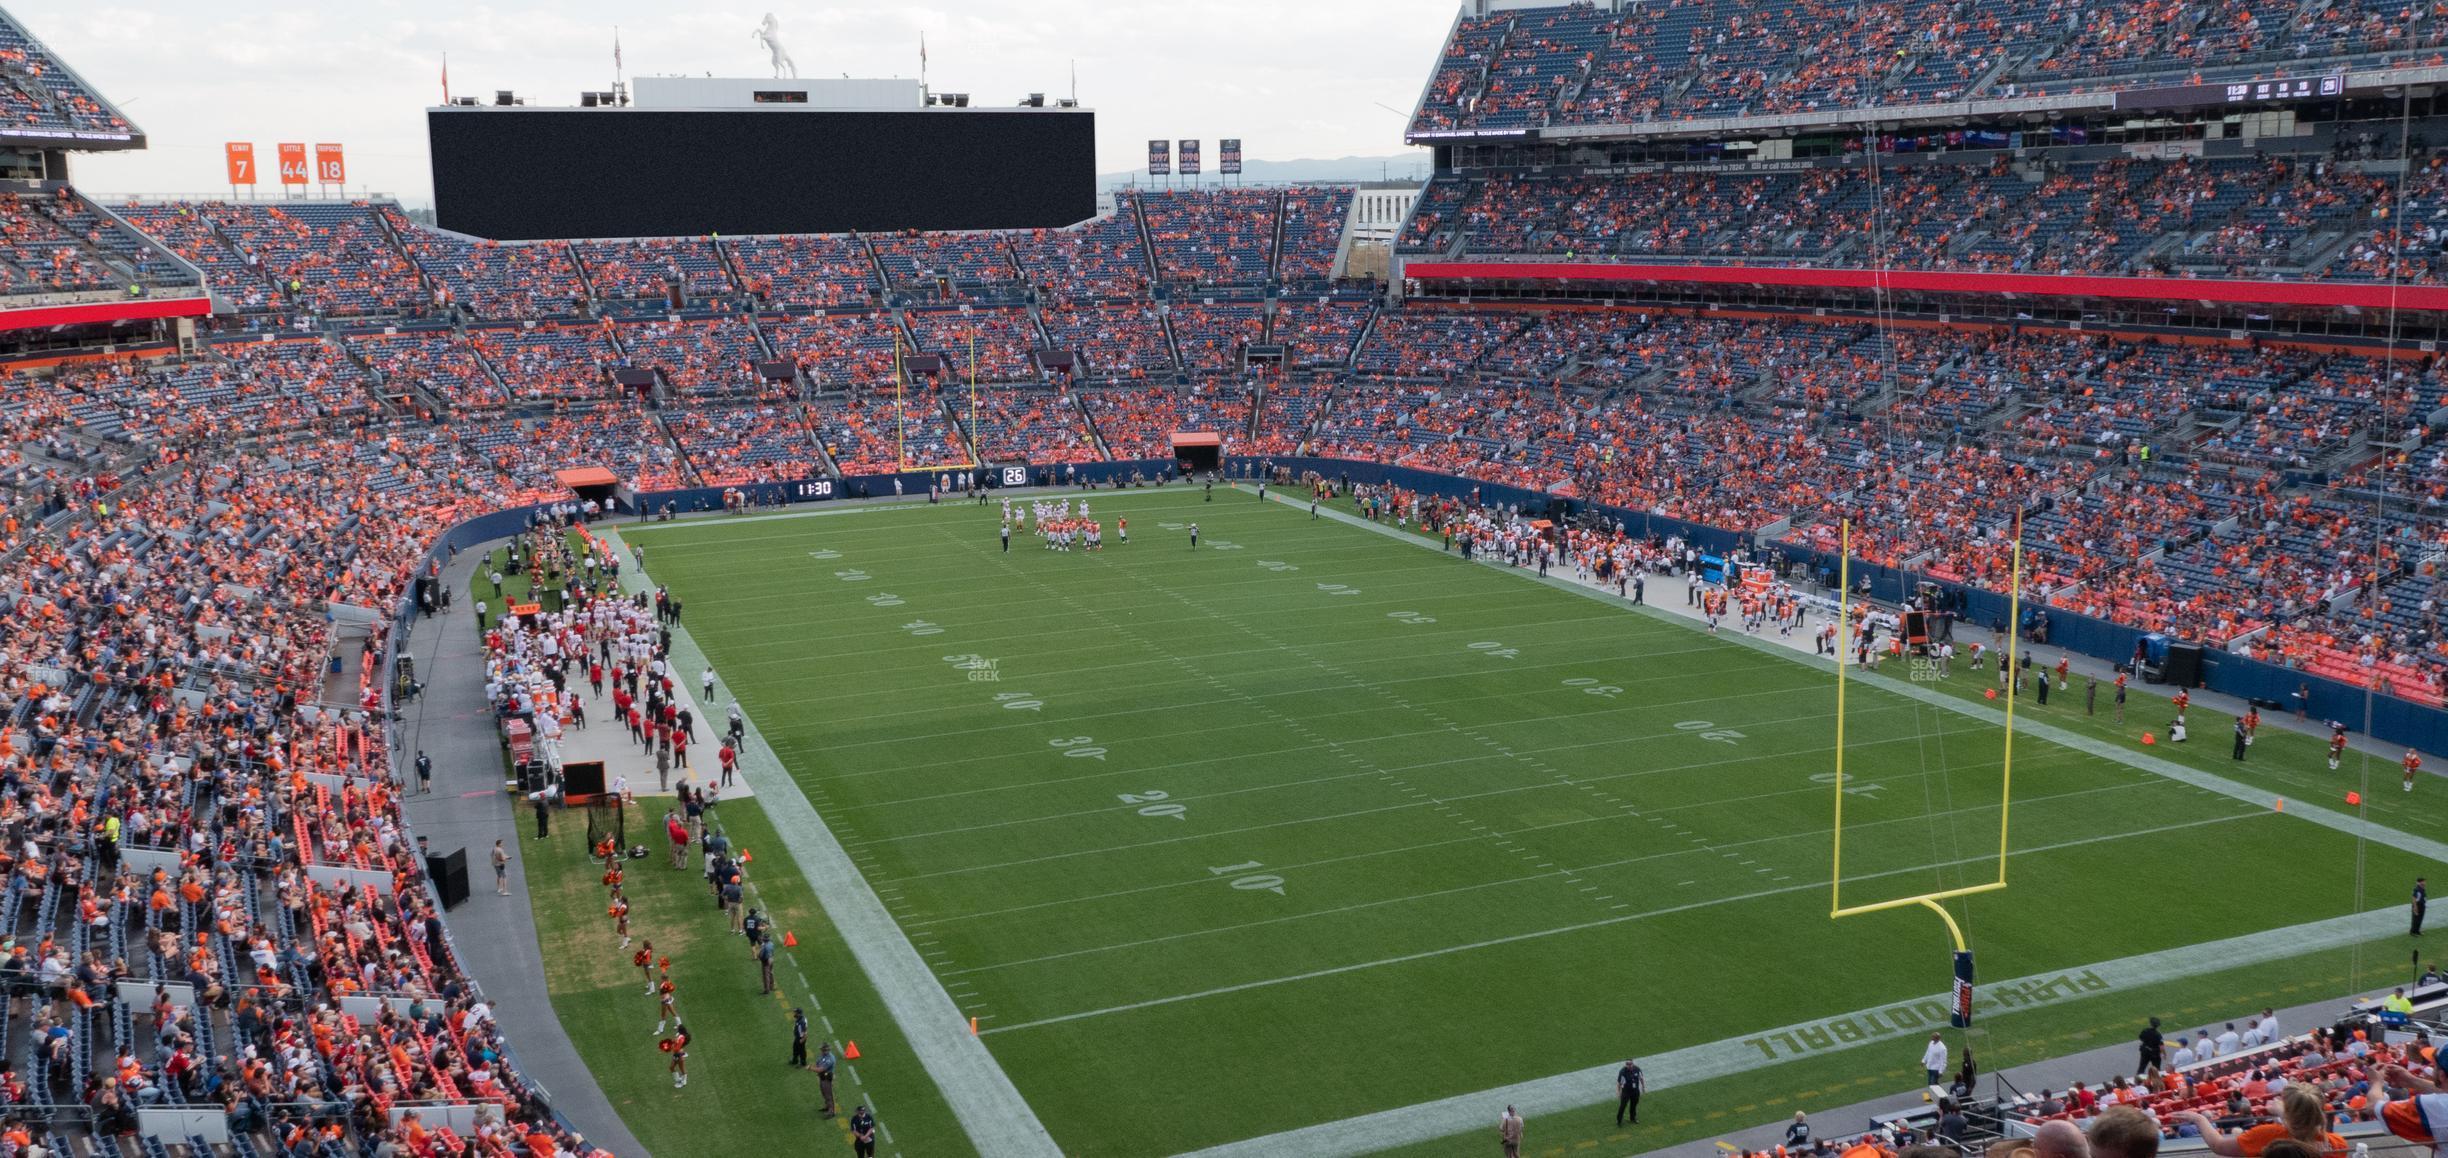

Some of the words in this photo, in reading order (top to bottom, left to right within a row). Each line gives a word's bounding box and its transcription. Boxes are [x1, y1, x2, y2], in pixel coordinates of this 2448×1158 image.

[1150, 153, 1169, 162] 1997
[1180, 152, 1199, 161] 1998
[1221, 152, 1240, 161] 2015
[236, 160, 247, 178] 7
[282, 161, 307, 178] 44
[321, 161, 342, 178] 18
[1006, 470, 1023, 482] 26
[799, 481, 831, 495] 11:30
[1049, 736, 1108, 758] 30
[1117, 790, 1187, 818] 20
[1207, 860, 1286, 892] 10
[1744, 1001, 1953, 1060] OOTBALL
